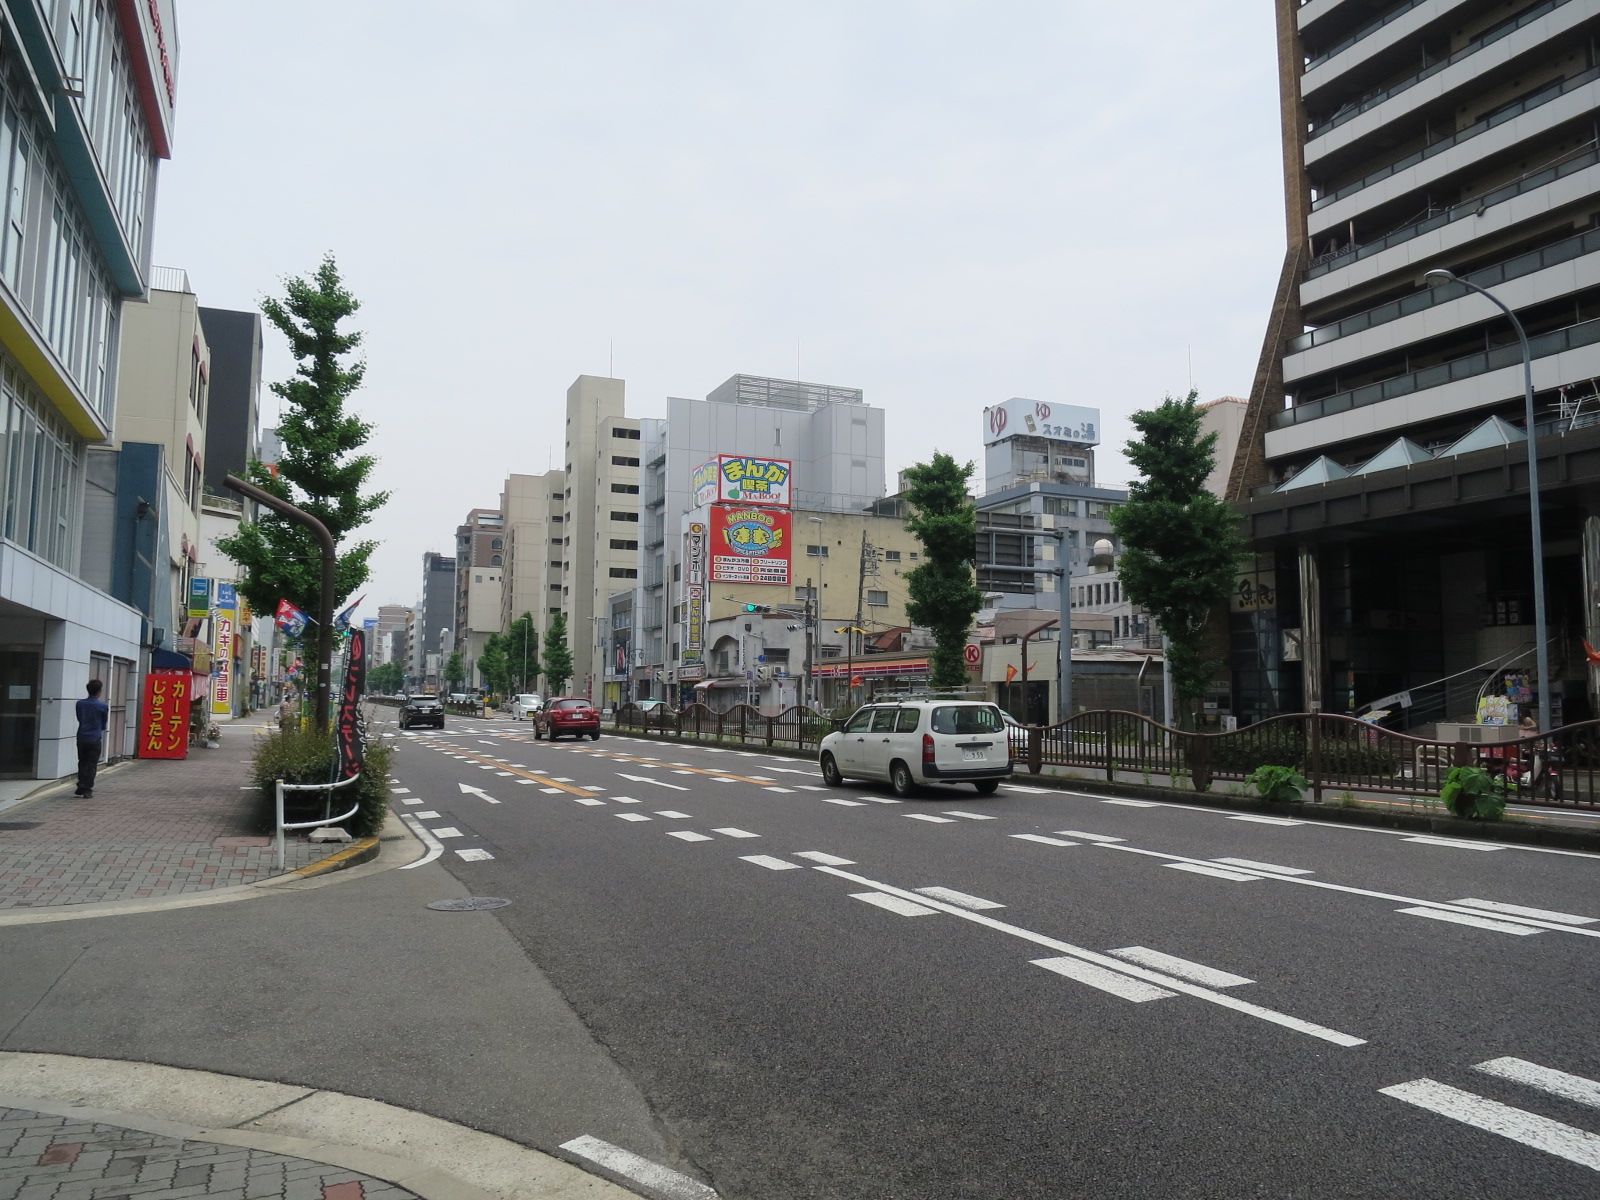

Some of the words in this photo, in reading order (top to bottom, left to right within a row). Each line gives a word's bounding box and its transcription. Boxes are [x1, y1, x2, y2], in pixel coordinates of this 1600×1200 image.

[990, 407, 1007, 437] ゆ
[1036, 402, 1050, 421] ゆ
[1043, 422, 1095, 440] スオミの湯
[724, 458, 789, 486] まんが
[727, 511, 775, 526] MANBOO
[147, 680, 167, 751] じゅうたん
[167, 679, 186, 752] カーテン
